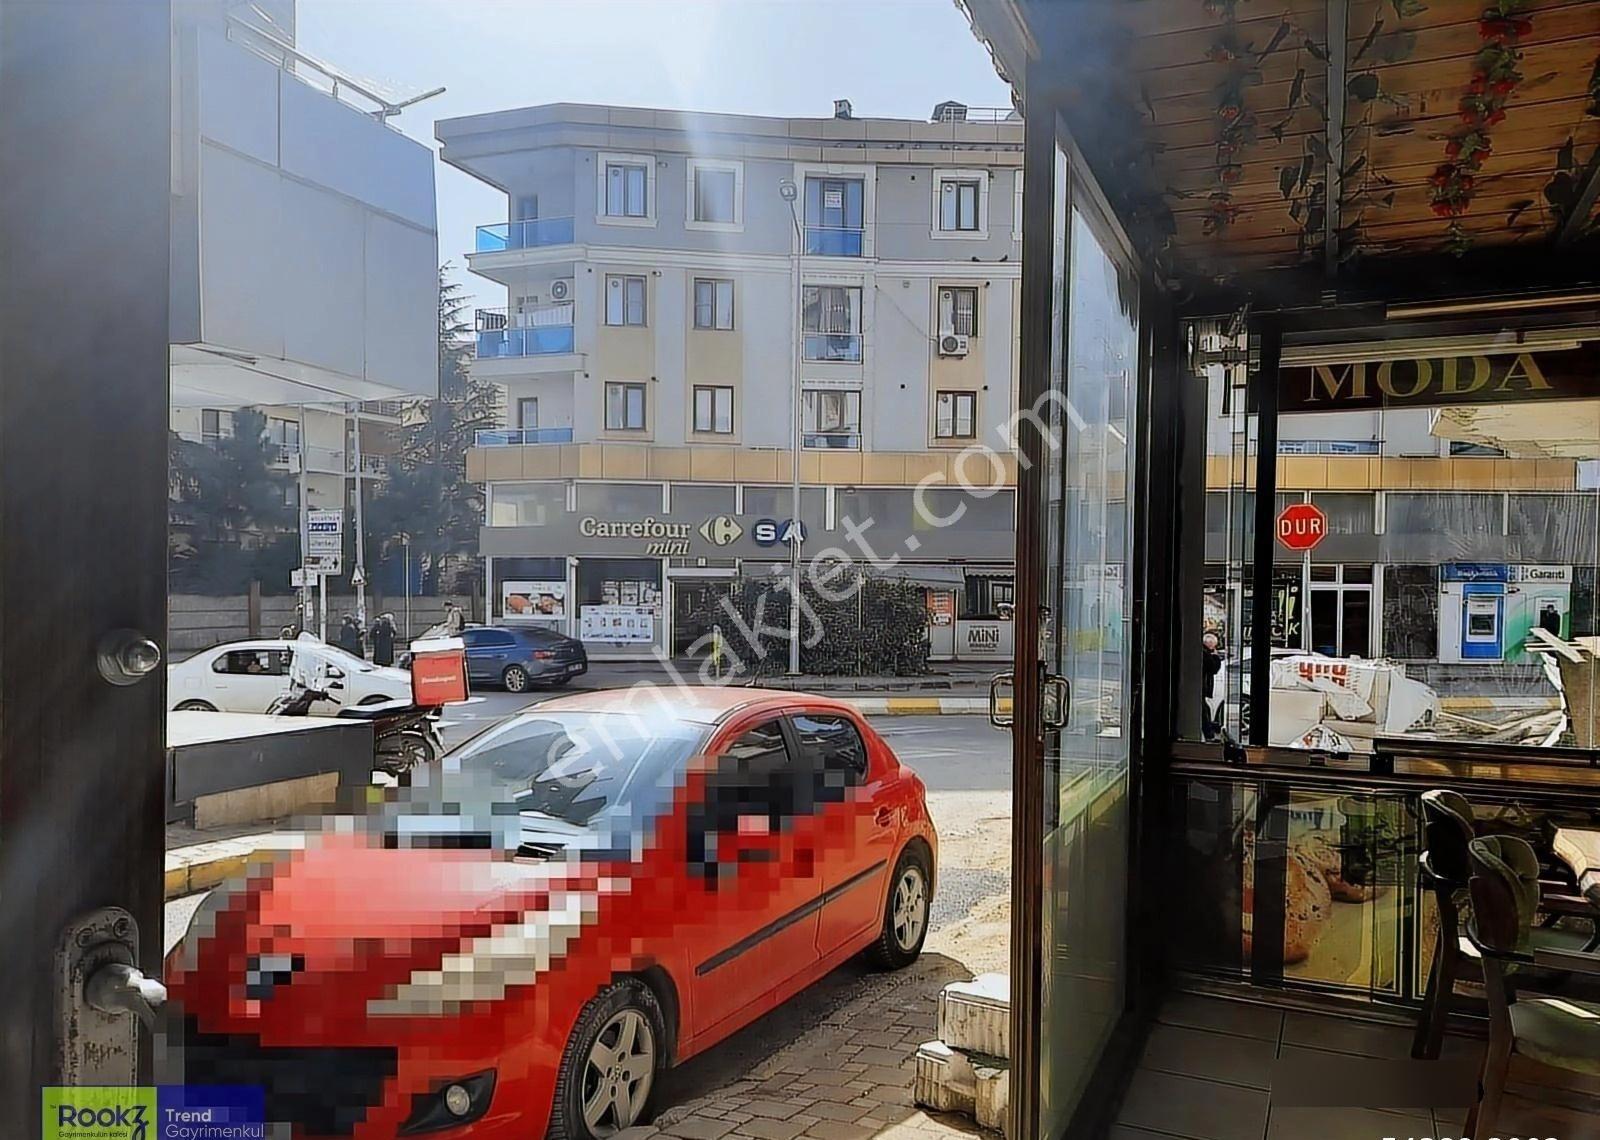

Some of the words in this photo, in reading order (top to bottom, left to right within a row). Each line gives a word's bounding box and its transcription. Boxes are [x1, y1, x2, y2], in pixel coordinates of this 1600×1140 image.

[1304, 352, 1553, 401] MODA
[580, 517, 690, 537] Carrefour
[1281, 519, 1322, 537] DUR
[645, 540, 690, 555] mini
[1529, 568, 1565, 579] Garanti
